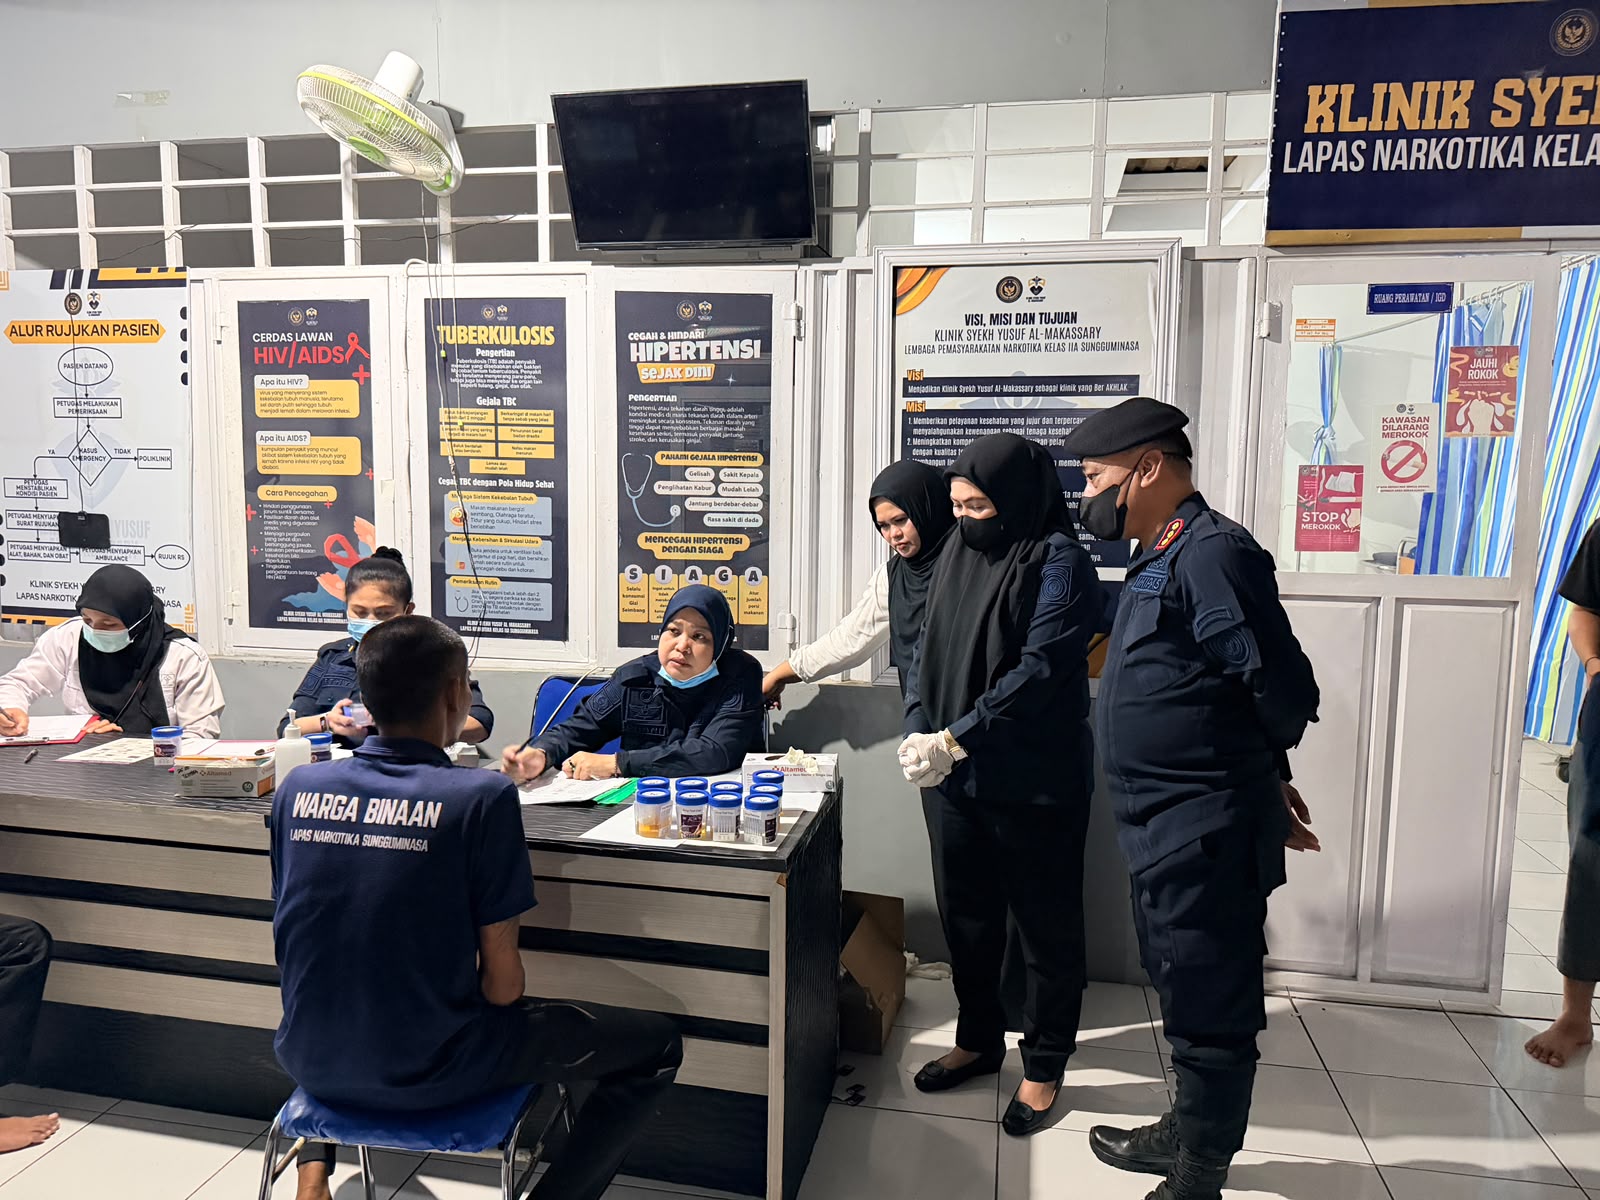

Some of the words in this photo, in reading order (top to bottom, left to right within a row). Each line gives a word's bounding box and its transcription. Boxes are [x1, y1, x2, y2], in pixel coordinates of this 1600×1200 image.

[1304, 80, 1475, 133] KLINIK
[1283, 139, 1367, 173] LAPAS
[1373, 136, 1524, 170] NARKOTIKA
[1374, 294, 1393, 303] RUANG
[1394, 292, 1429, 303] PERAWATAN
[1436, 292, 1446, 302] IGD
[965, 314, 986, 327] VISI,
[990, 313, 1012, 326] MISI
[1016, 313, 1035, 325] DAN
[1039, 311, 1078, 324] TUJUAN
[10, 324, 43, 337] ALUR
[46, 324, 109, 336] RUJUKAN
[113, 323, 160, 336] PASIEN
[660, 331, 666, 339] &
[934, 329, 963, 342] KLINIK
[967, 329, 994, 341] SYEKH
[998, 328, 1026, 340] YUSUF
[1029, 327, 1101, 340] AL-MAKASSARY
[253, 333, 293, 342] CERDAS
[295, 332, 333, 342] LAWAN
[437, 325, 556, 346] TUBERKULOSIS
[476, 348, 515, 357] Pengertian
[630, 339, 761, 362] HIPERTENSI
[904, 344, 936, 355] LEMBAGA
[938, 344, 1000, 354] PEMASYARAKATAN
[1003, 343, 1042, 353] NARKOTIKA
[1044, 342, 1066, 352] KELAS
[1068, 342, 1079, 352] IIA
[1081, 341, 1140, 352] SUNGGUMINASA
[254, 341, 344, 368] HIV/AIDS
[1470, 359, 1497, 368] JAUHI
[907, 369, 924, 381] Visi
[1468, 369, 1498, 380] ROKOK
[260, 379, 274, 387] Apa
[908, 385, 940, 393] Menjadikan
[960, 385, 976, 394] Syekh
[995, 384, 1033, 393] Al-Makassary
[1035, 384, 1058, 393] sebagai
[1078, 384, 1092, 392] yang
[476, 396, 500, 406] Gejala
[503, 397, 517, 406] TBC
[906, 401, 926, 412] Misi
[949, 417, 978, 425] pelayanan
[1026, 417, 1040, 425] jujur
[913, 428, 963, 436] menyalahgunakan
[1026, 428, 1046, 436] tenaga
[260, 435, 274, 443] Apa
[913, 438, 951, 446] Meningkatkan
[912, 448, 931, 456] dengan
[934, 448, 957, 456] kualitas
[460, 478, 471, 486] TBC
[473, 478, 497, 488] dengan
[499, 479, 514, 487] Pola
[515, 480, 534, 489] Hidup
[536, 480, 554, 488] Sehat
[658, 484, 693, 492] Penglihatan
[284, 490, 328, 498] Pencegahan
[1302, 512, 1338, 522] STOP
[698, 546, 724, 554] SIAGA
[630, 568, 638, 580] S
[662, 568, 666, 580] I
[688, 570, 698, 580] A
[718, 570, 729, 581] G
[748, 570, 758, 582] A
[30, 580, 53, 588] KLINIK
[41, 594, 77, 602] NARKOTIK
[292, 792, 359, 822] WARGA
[363, 798, 442, 828] BINAAN
[290, 829, 312, 841] LAPAS
[313, 830, 360, 846] NARKOTIKA
[362, 834, 428, 852] SUNGGUMINASA
